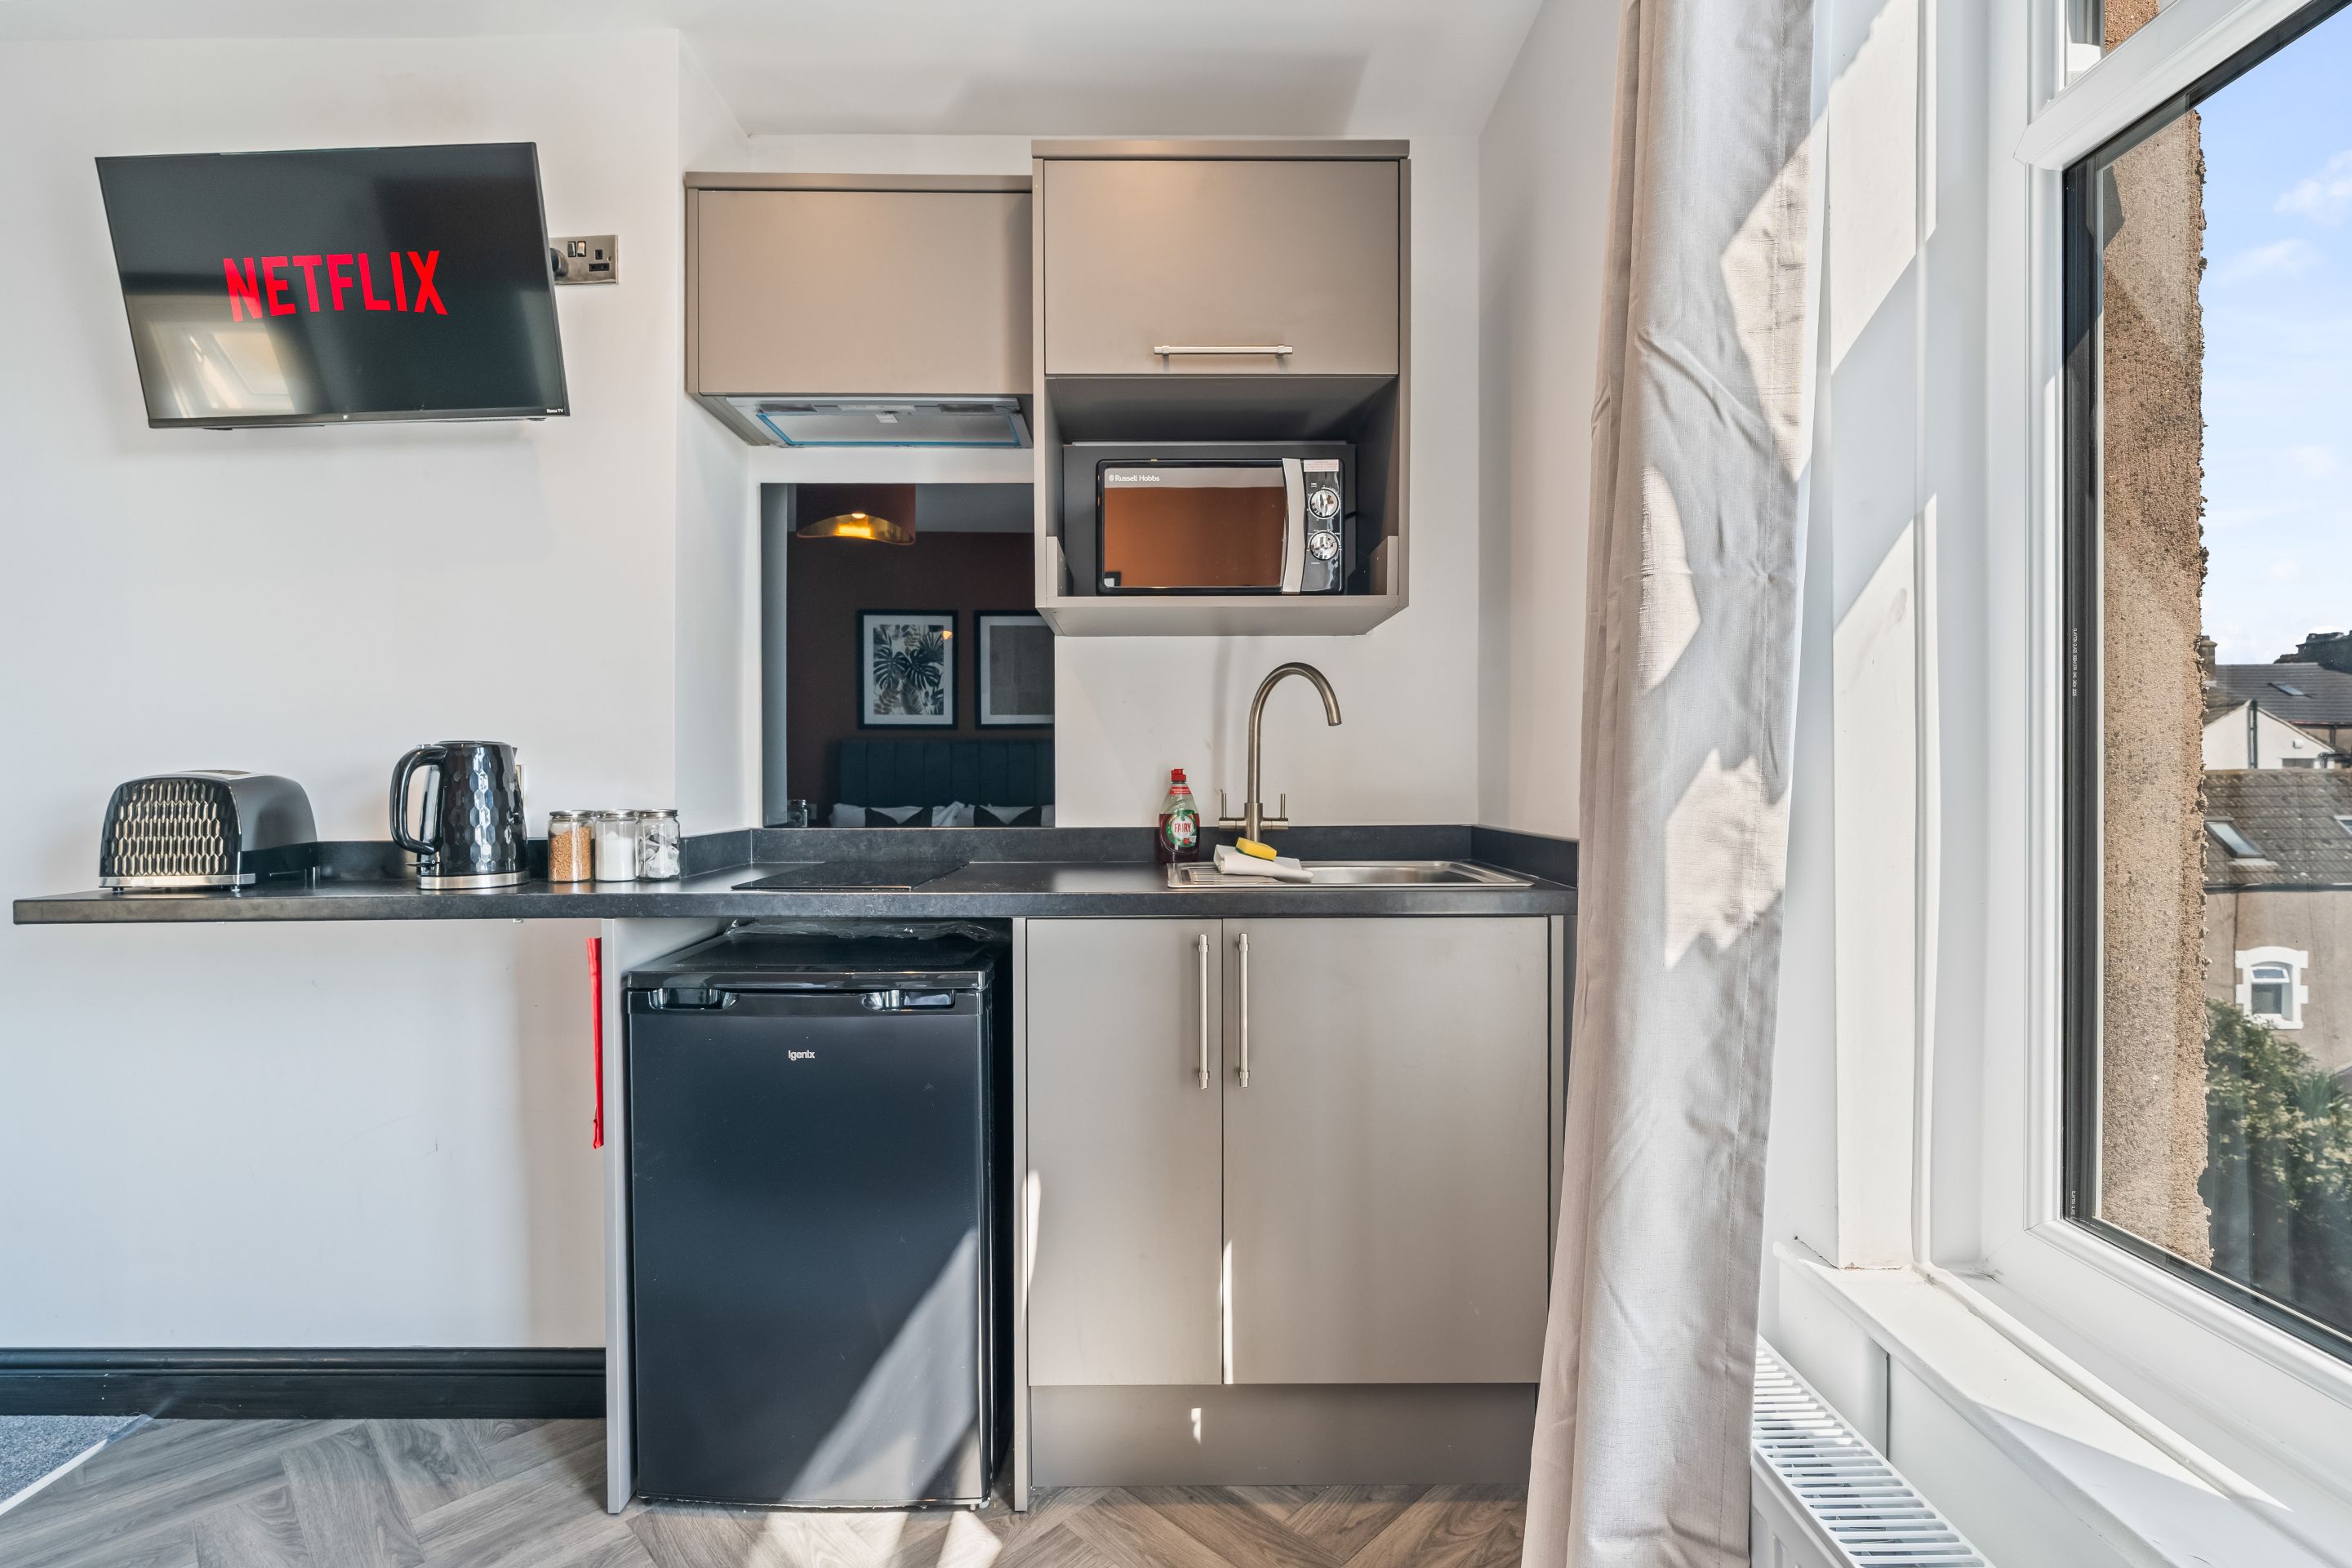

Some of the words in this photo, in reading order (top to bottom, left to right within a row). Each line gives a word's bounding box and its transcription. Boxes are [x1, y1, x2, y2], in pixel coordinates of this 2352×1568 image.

[223, 250, 448, 322] NETFLIX
[1174, 823, 1191, 833] FAIRY
[788, 1050, 816, 1061] Igenix
